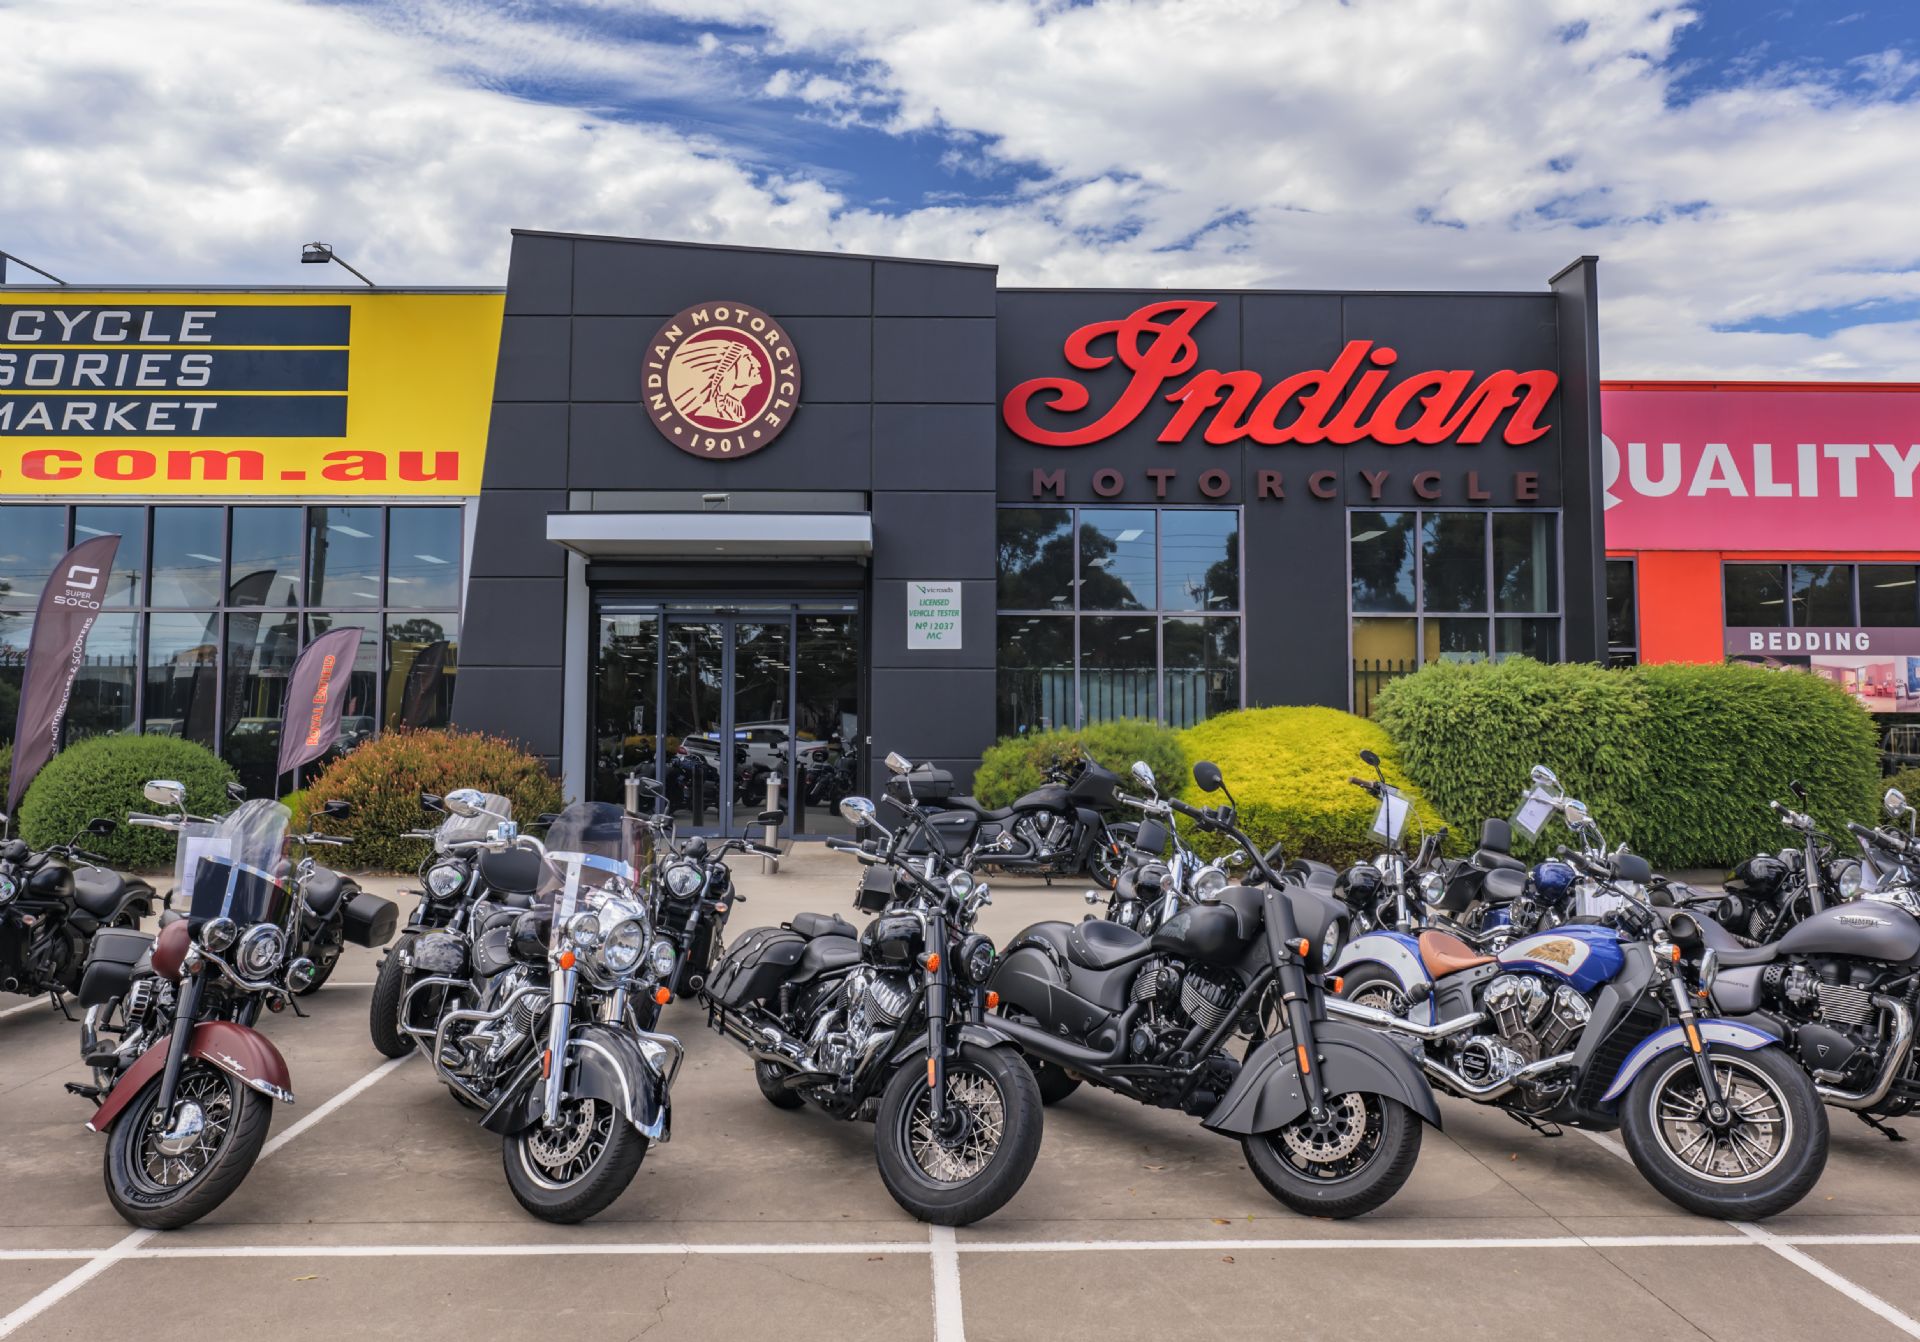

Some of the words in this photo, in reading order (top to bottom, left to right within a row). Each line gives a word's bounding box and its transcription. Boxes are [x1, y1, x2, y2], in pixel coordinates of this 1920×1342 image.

[8, 310, 217, 342] CYCLE
[648, 325, 683, 421] INDIAN
[691, 307, 794, 427] MOTORCYCLE
[1002, 300, 1557, 447] Indian
[690, 434, 745, 452] 1901
[0, 450, 459, 482] com.au
[1032, 468, 1540, 500] MOTORCYCLE
[53, 596, 100, 610] SOCO
[66, 590, 91, 599] SUPER
[72, 617, 93, 665] SCOOTERS
[926, 632, 943, 640] MC
[1750, 632, 1870, 651] BEDDING
